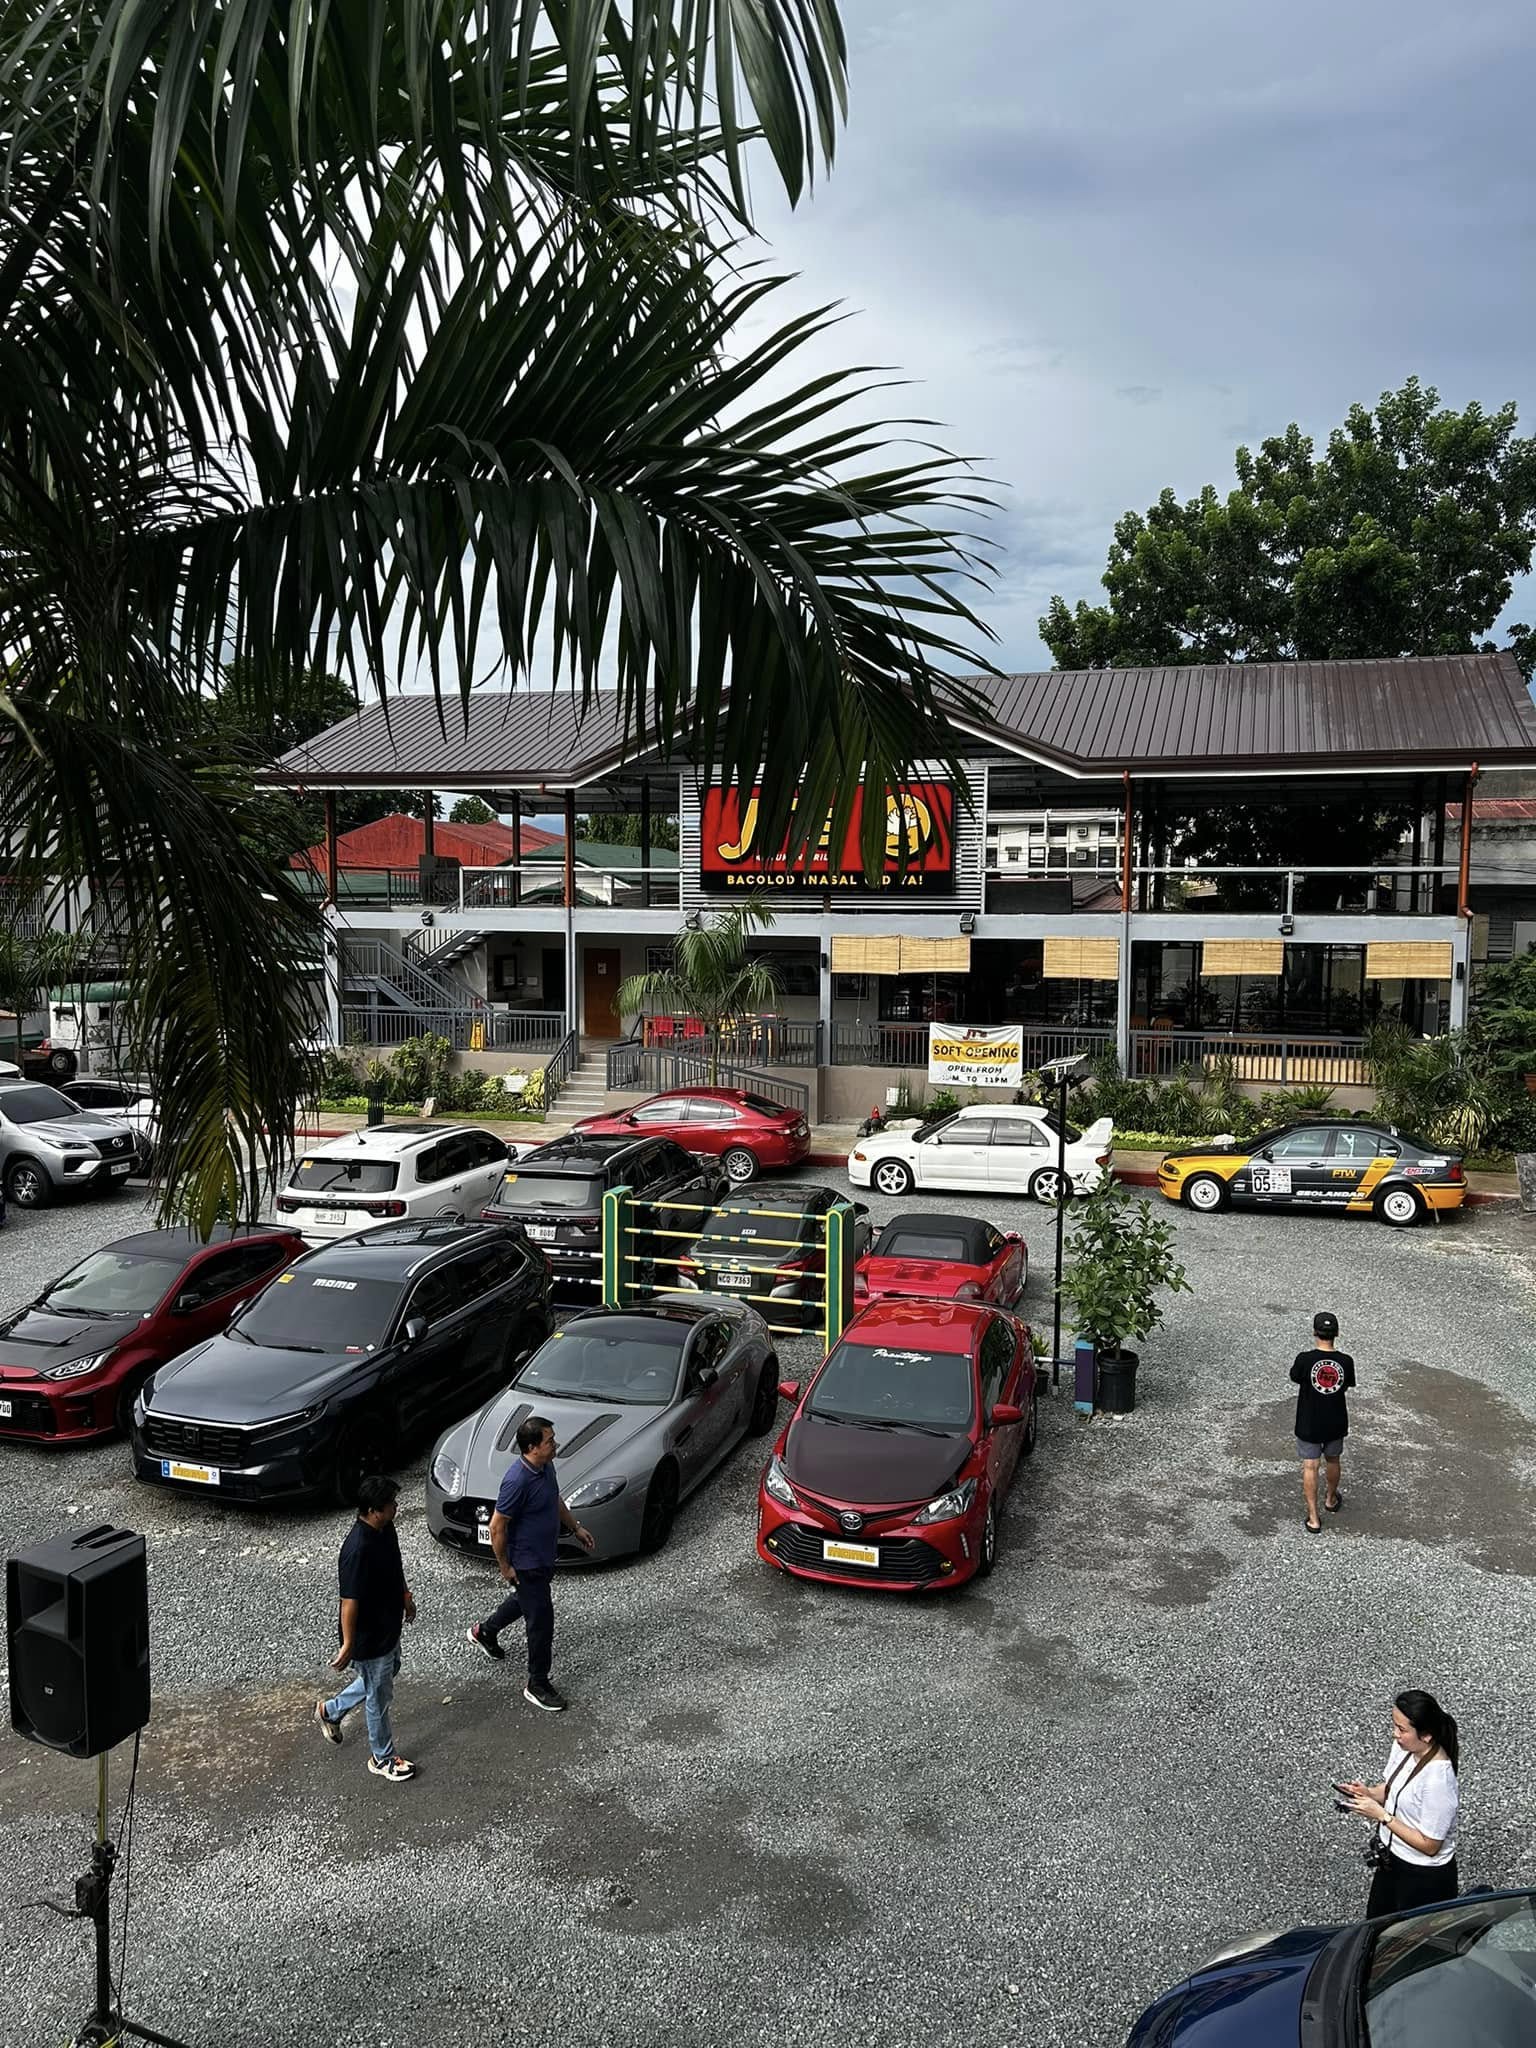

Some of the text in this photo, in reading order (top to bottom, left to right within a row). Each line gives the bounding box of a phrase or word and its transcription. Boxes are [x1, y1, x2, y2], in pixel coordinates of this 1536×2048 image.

[727, 875, 795, 885] BACOLOD
[802, 875, 857, 885] INASAL
[934, 1045, 1018, 1058] SOFT OPENING
[947, 1065, 1002, 1074] OPEN FROM
[1332, 1169, 1357, 1178] FTW
[1254, 1176, 1271, 1192] 05
[1296, 1190, 1366, 1198] GEOLANDAR
[479, 1529, 490, 1541] NB
